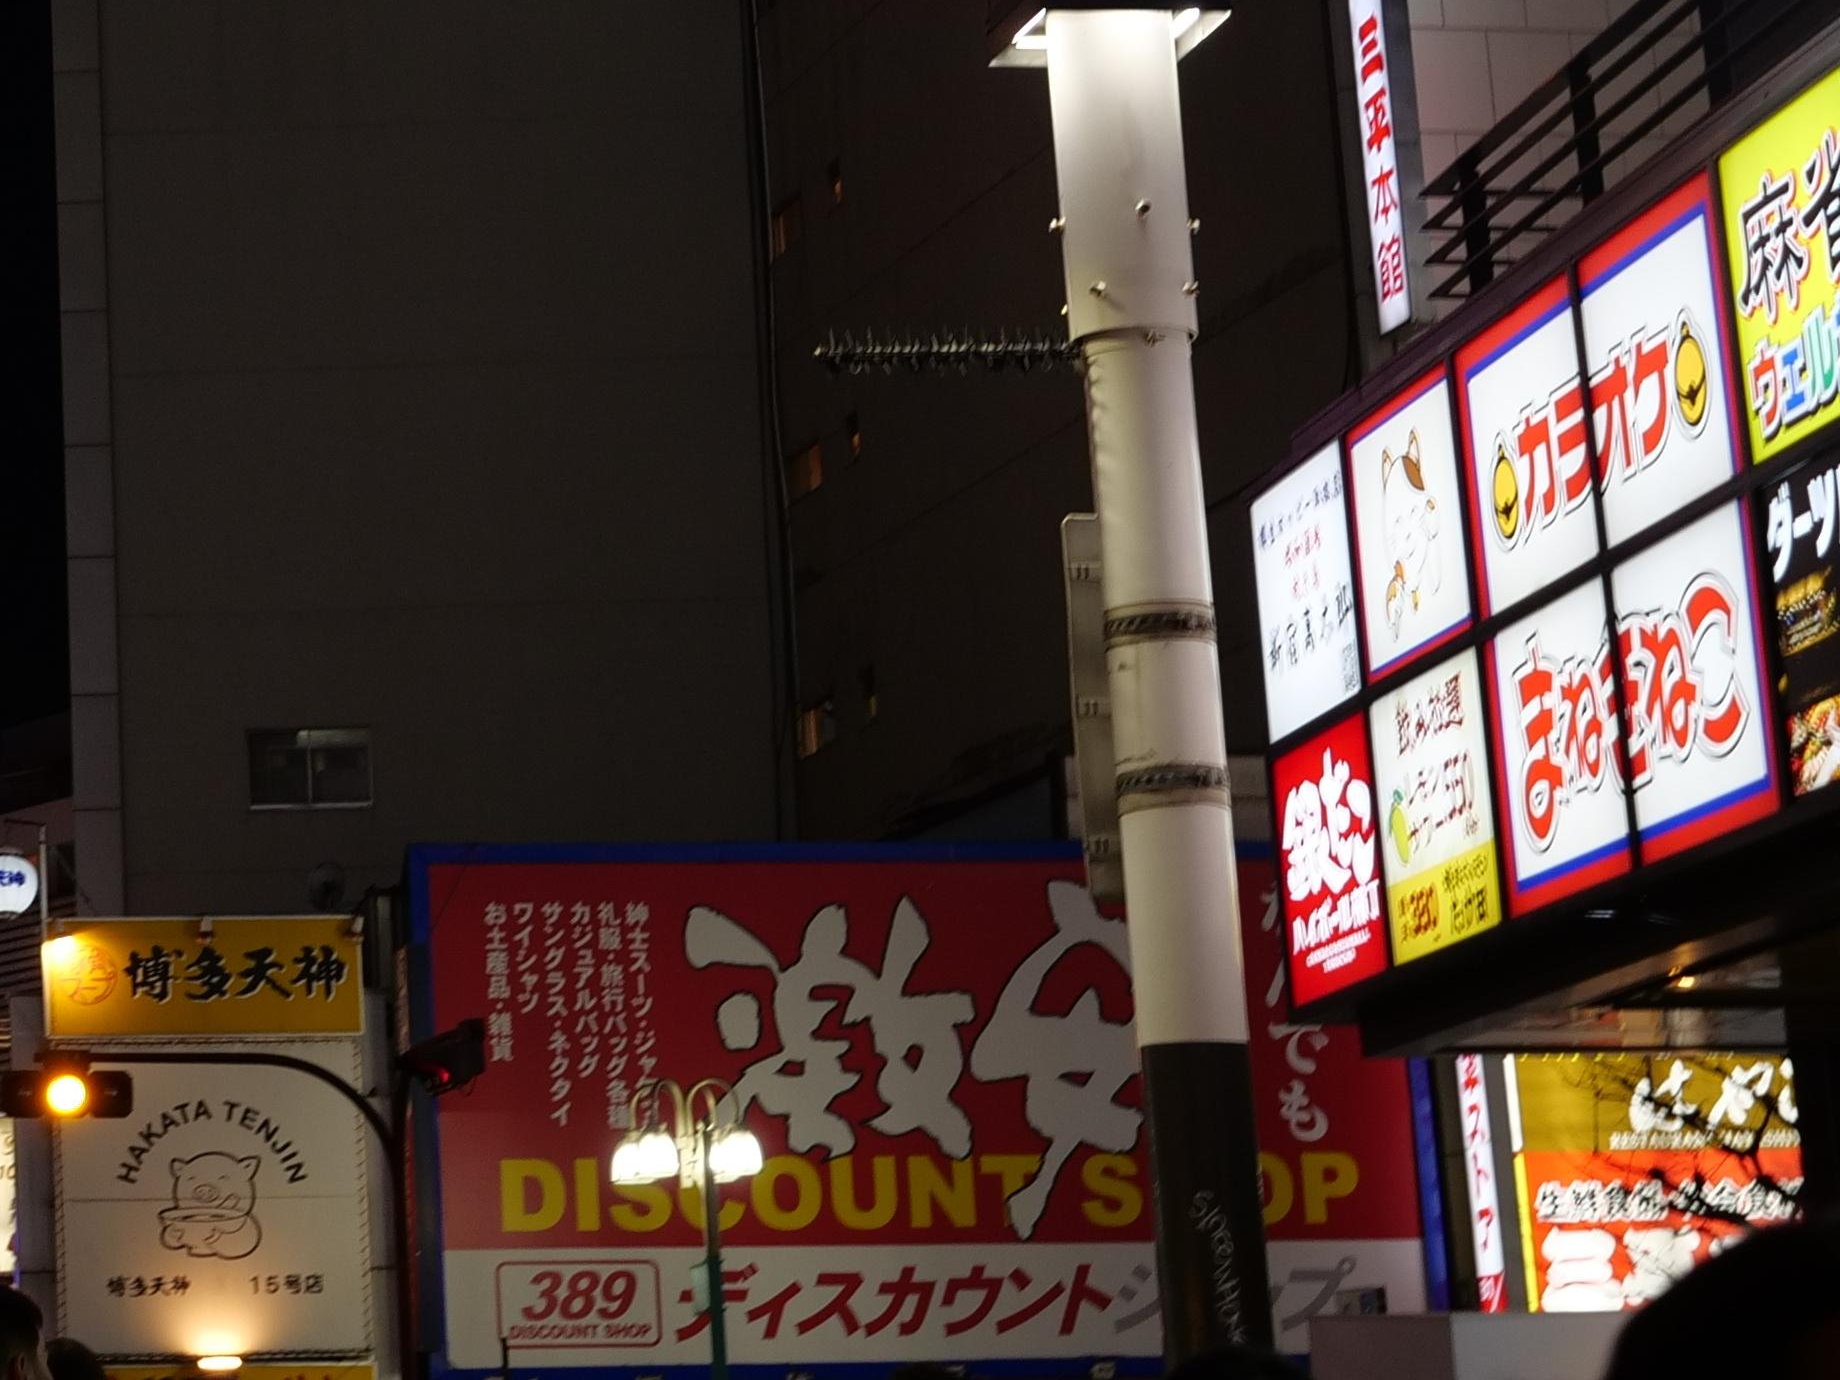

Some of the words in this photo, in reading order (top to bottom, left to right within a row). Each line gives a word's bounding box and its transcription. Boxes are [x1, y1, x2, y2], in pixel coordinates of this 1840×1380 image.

[1358, 12, 1404, 305] 三平本館
[1513, 328, 1672, 532] カラオケ
[1516, 582, 1746, 842] まねきねこ
[123, 944, 348, 1005] 博多天神
[512, 901, 540, 1015] ワイシャツ
[570, 900, 601, 1078] カジュアルバッグ
[117, 1099, 213, 1184] HAKATA
[222, 1100, 309, 1184] TENJIN
[1081, 1151, 1360, 1229] SOP
[106, 1275, 191, 1298] 博多天神
[249, 1274, 325, 1296] 15号店
[522, 1270, 637, 1321] 389
[676, 1254, 1357, 1342] ディスカウントシプ
[509, 1322, 600, 1340] DISCOUNT
[604, 1322, 652, 1339] SHOP
